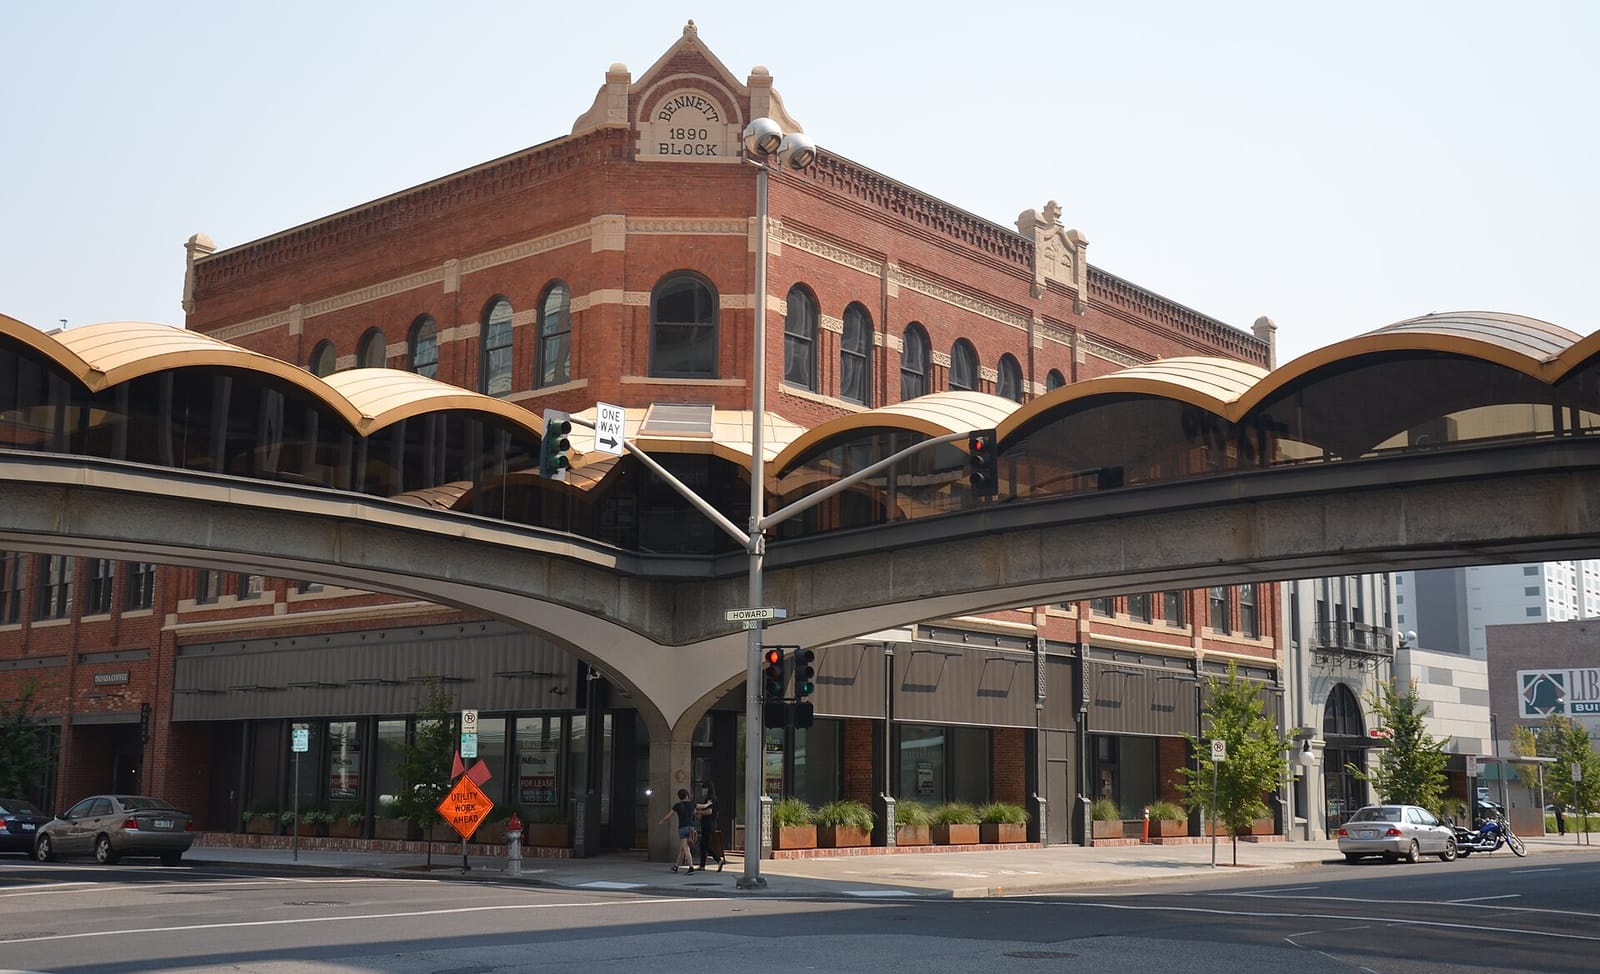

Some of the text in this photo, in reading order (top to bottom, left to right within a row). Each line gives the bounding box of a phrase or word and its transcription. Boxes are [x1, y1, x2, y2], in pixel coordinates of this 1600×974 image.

[659, 95, 720, 122] BENNETT
[669, 128, 708, 140] 1890
[659, 143, 718, 156] BLOCK
[601, 408, 621, 423] ONE
[600, 420, 621, 435] WAY
[733, 610, 768, 619] HOWARD
[1567, 670, 1600, 701] LIB
[1575, 703, 1600, 712] BUI
[450, 791, 479, 802] UTILITY
[455, 803, 475, 813] WORK
[453, 814, 479, 824] AHEAD
